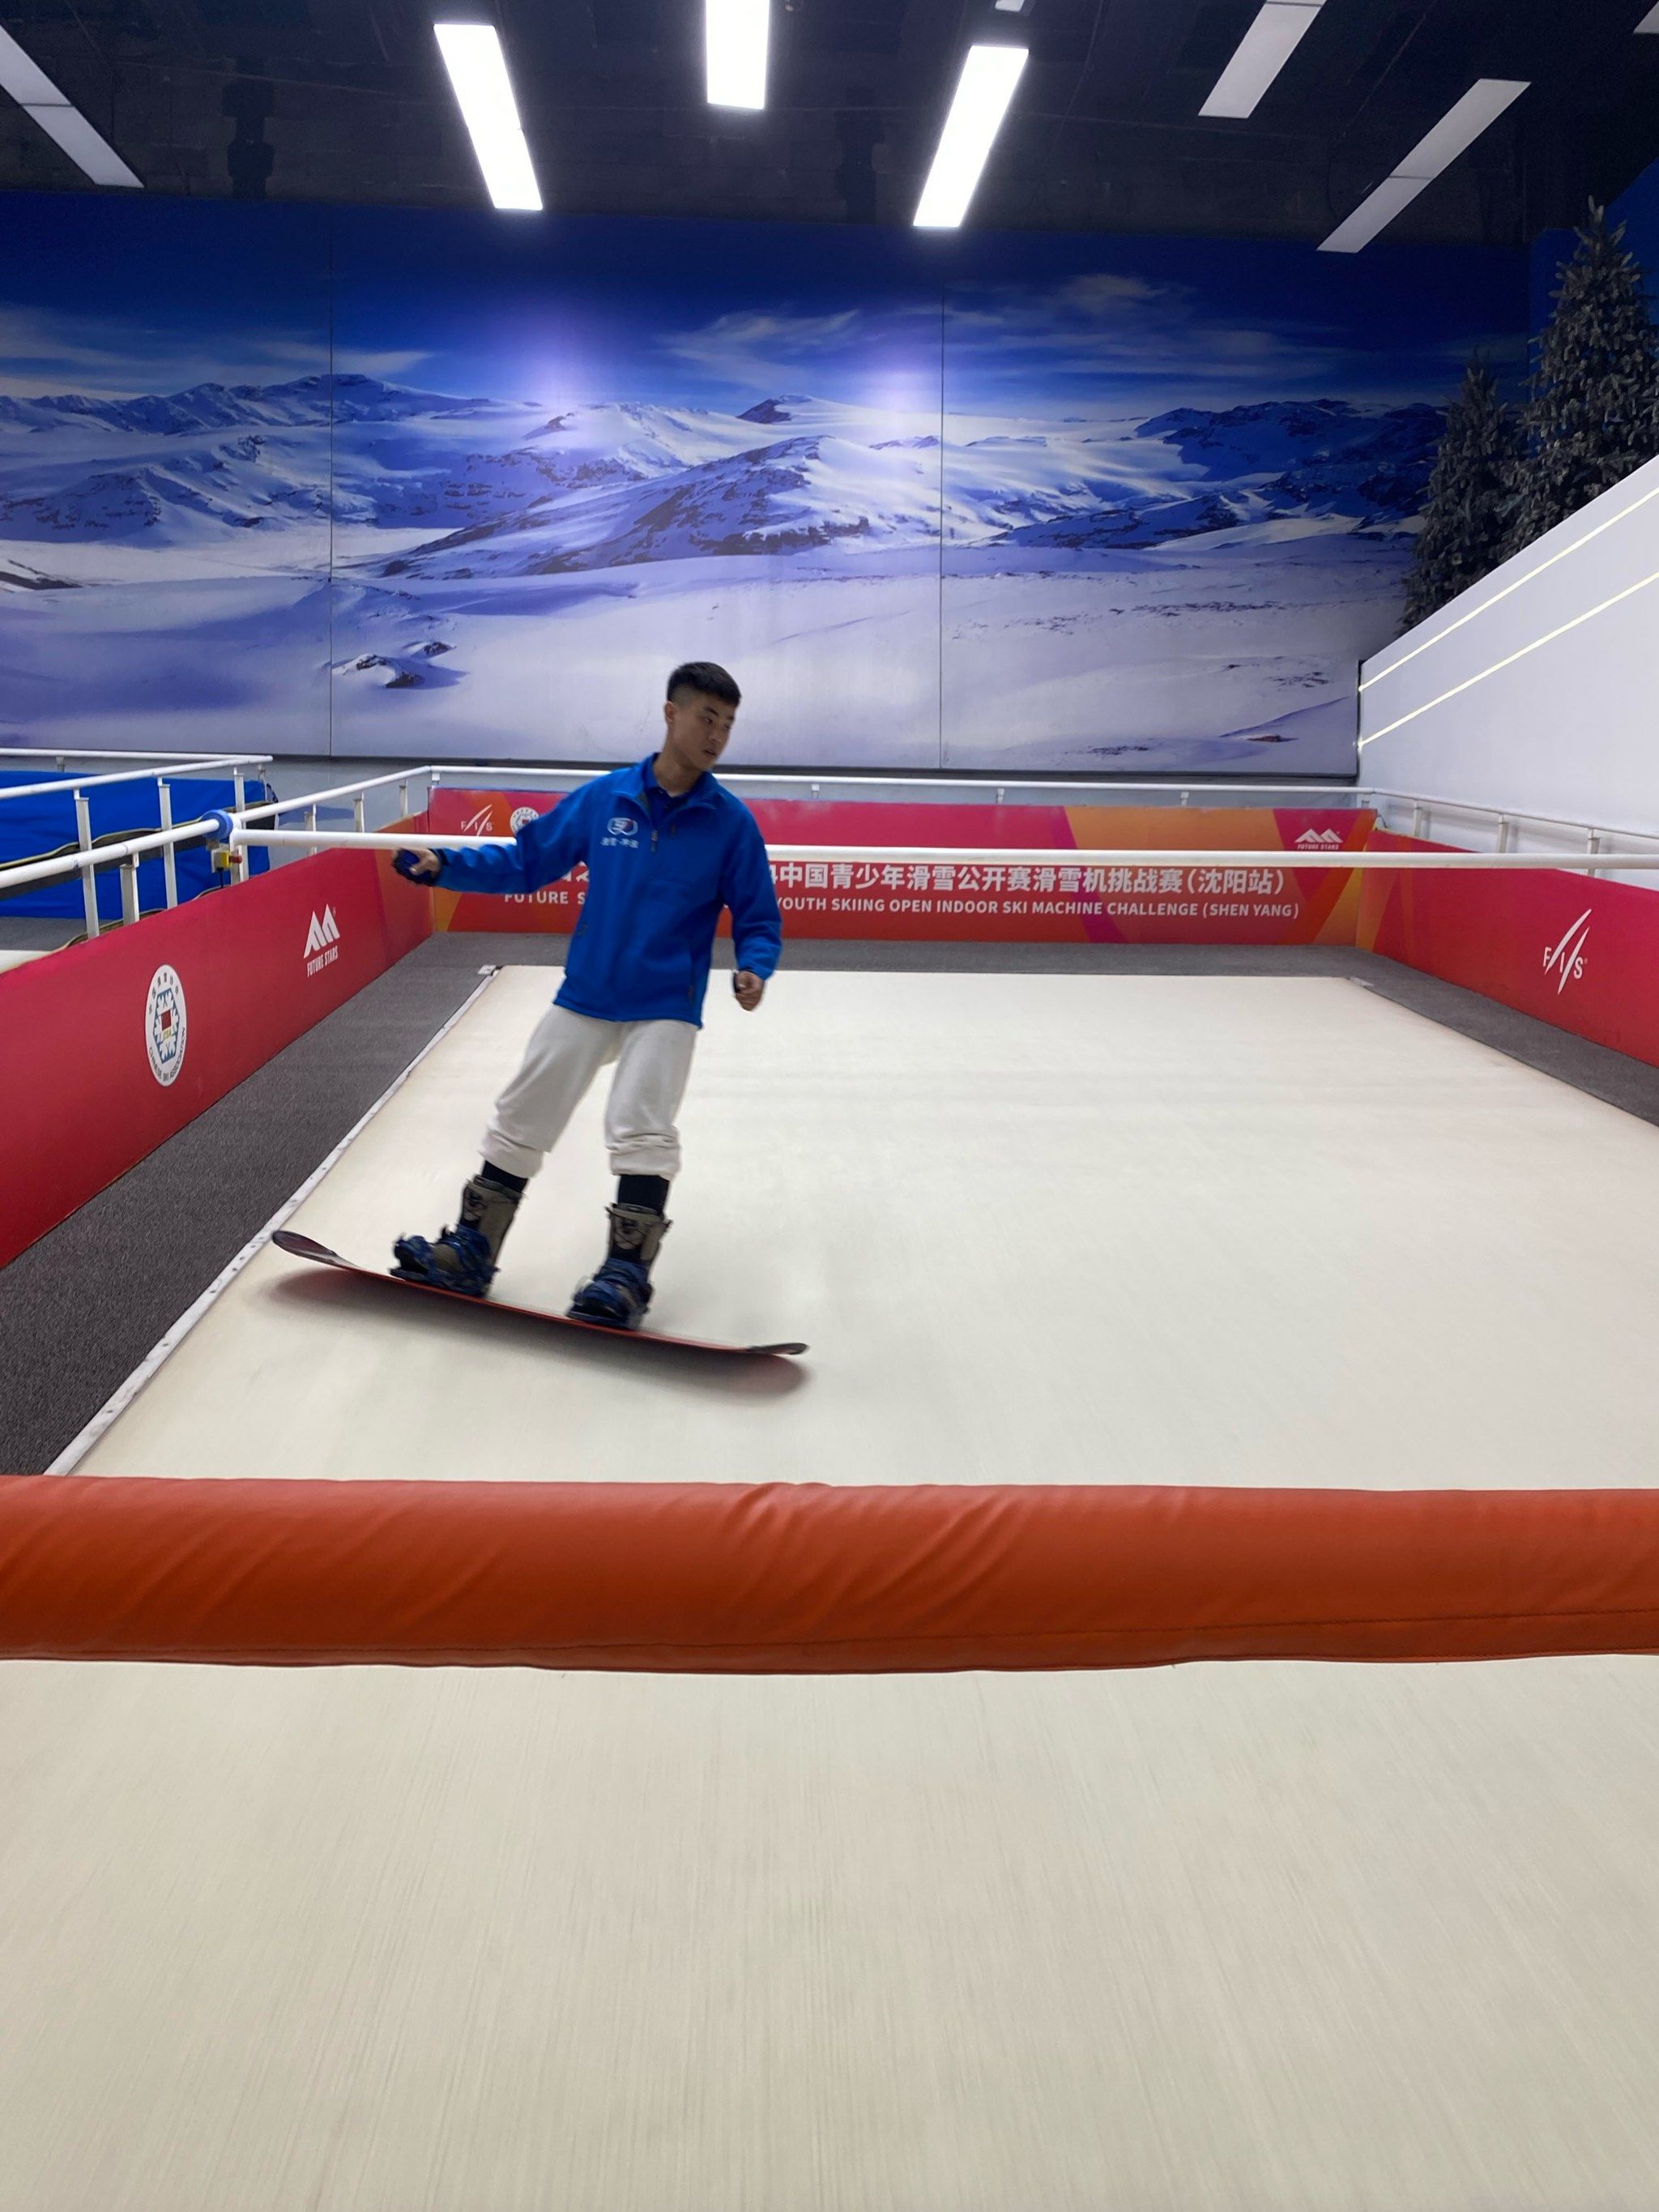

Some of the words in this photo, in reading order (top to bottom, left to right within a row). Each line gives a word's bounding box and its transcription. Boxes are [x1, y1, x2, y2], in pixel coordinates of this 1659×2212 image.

[505, 890, 569, 904] FUTURE
[832, 898, 885, 912] SKIING
[889, 899, 932, 912] OPEN
[936, 900, 998, 914] INDOOR
[1003, 901, 1027, 914] SKI
[1032, 901, 1102, 915] MACHINE
[1107, 902, 1198, 916] CHALLENGE
[1202, 903, 1249, 918] (SHEN
[1254, 903, 1299, 919] YANG)
[307, 954, 324, 978] FUTURE
[325, 946, 339, 966] STARS
